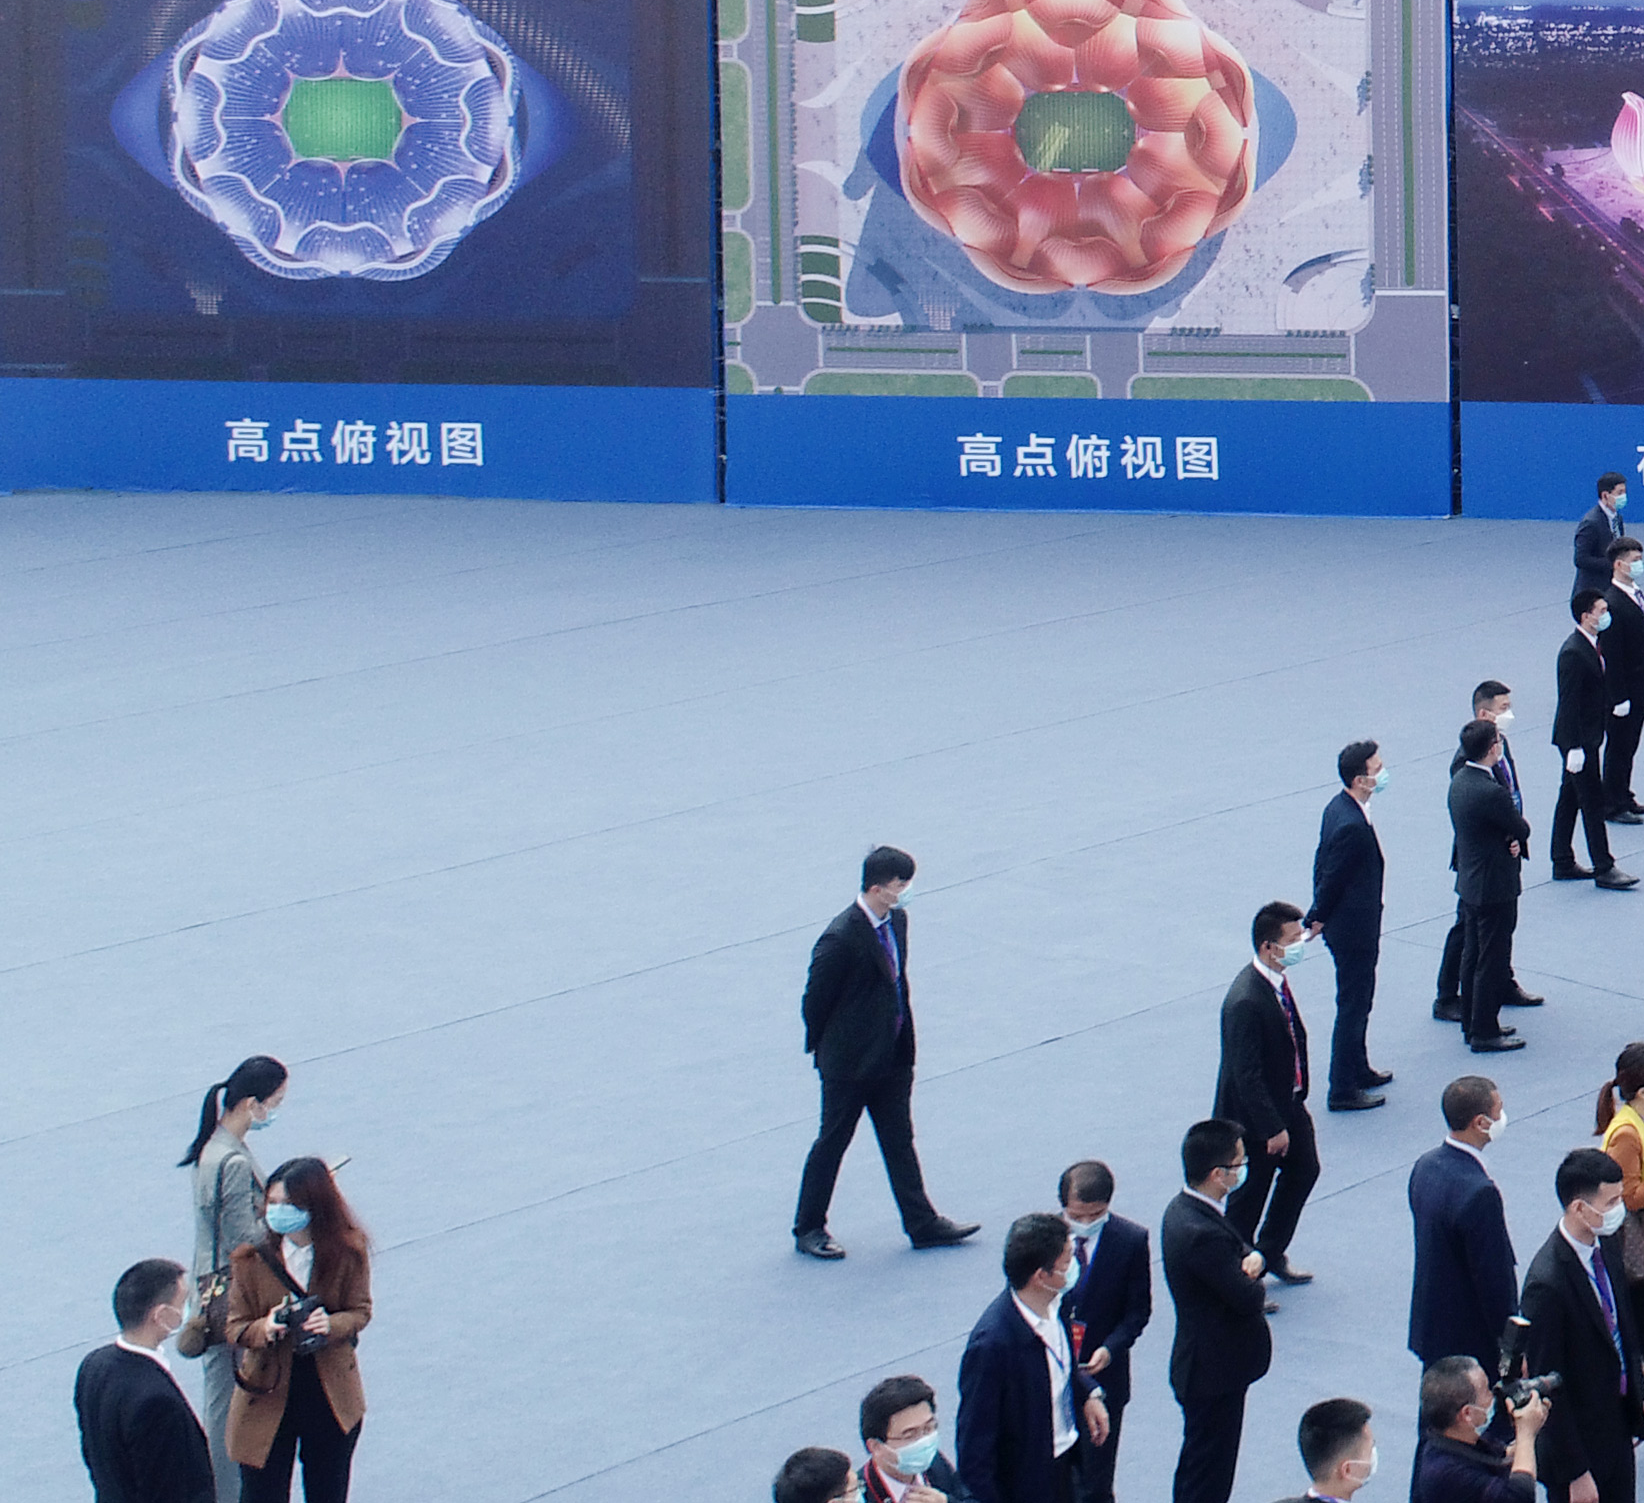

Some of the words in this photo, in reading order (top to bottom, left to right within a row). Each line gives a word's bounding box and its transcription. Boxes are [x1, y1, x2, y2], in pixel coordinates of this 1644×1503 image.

[225, 418, 484, 466] 高点俯视图
[957, 432, 1218, 480] 高点俯视图
